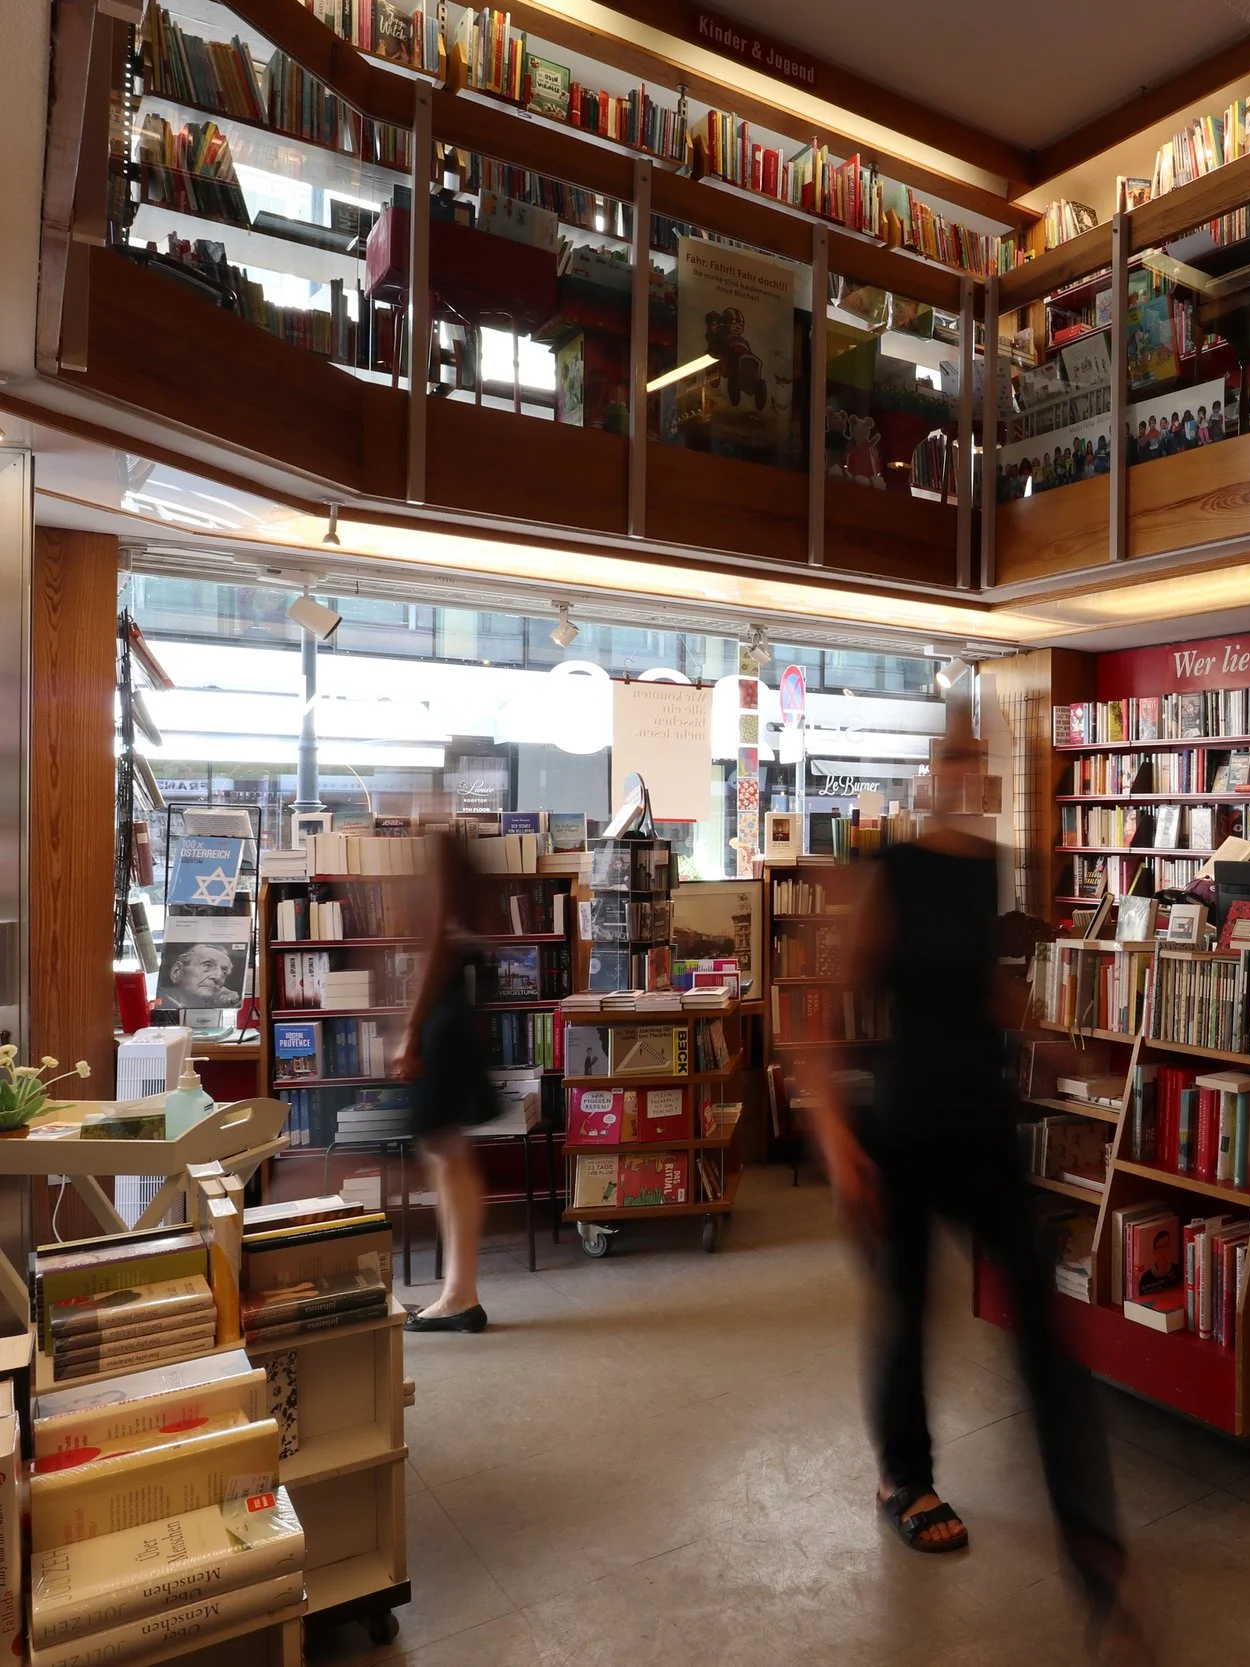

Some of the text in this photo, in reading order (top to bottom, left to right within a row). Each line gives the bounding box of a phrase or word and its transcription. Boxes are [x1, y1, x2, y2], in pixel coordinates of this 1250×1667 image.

[699, 15, 815, 84] Kinder & Jugend
[704, 271, 724, 284] vorne
[724, 278, 739, 289] sind
[737, 269, 757, 281] Fahr
[716, 284, 733, 295] neue
[1173, 650, 1217, 679] Wer
[818, 774, 881, 796] Le Burner
[181, 848, 231, 860] ÖSTERREICH
[499, 987, 538, 997] VERGELTUNG
[279, 1038, 312, 1049] PROVENCE
[663, 1163, 674, 1196] RITUAL
[672, 1169, 681, 1185] DAS
[303, 1299, 337, 1313] Johanna
[306, 1316, 341, 1330] Johanna
[134, 1537, 158, 1563] Über
[161, 1519, 189, 1565] Menschen
[41, 1549, 70, 1579] ZEH
[143, 1566, 222, 1598] Menschen
[2, 1590, 16, 1634] Fallada
[43, 1602, 128, 1639] JULI ZEH
[142, 1602, 220, 1635] Menschen
[86, 1639, 126, 1664] JULI
